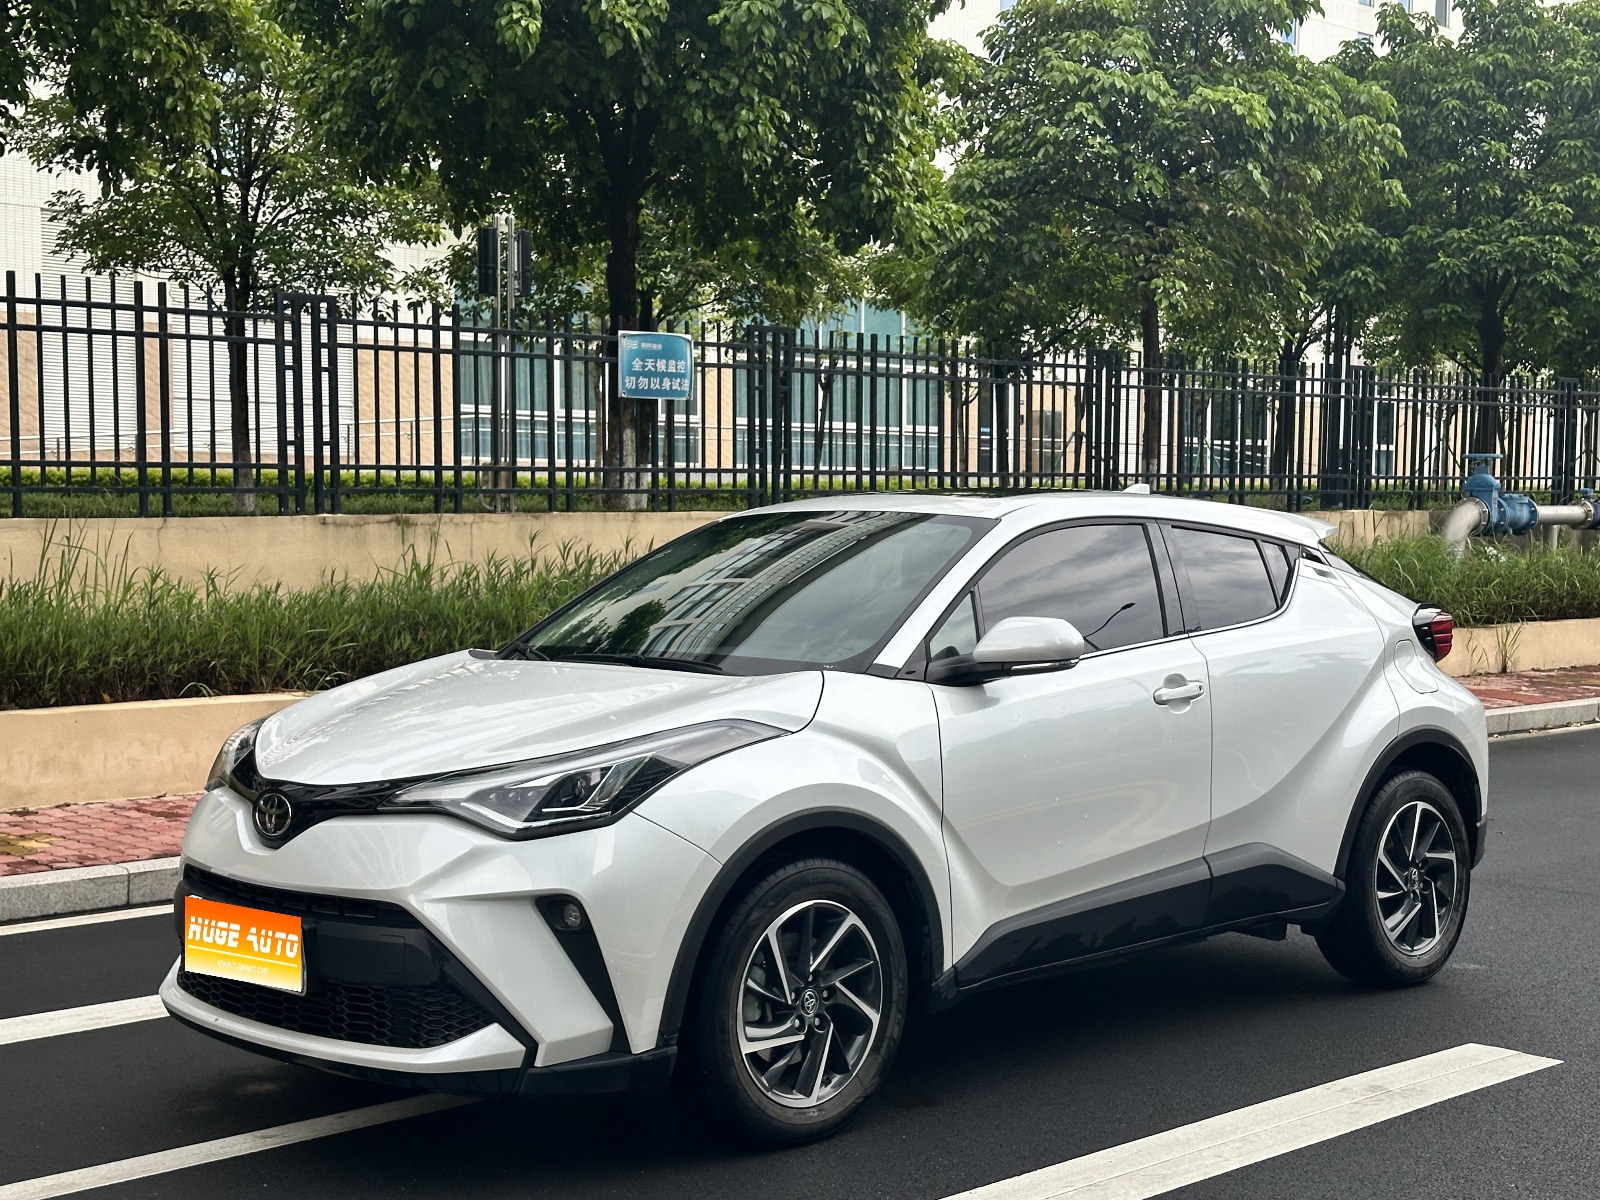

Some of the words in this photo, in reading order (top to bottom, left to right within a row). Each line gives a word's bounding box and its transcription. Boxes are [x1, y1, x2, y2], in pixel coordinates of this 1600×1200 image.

[631, 357, 686, 373] 全天候监控
[625, 376, 689, 391] 切勿以身试法
